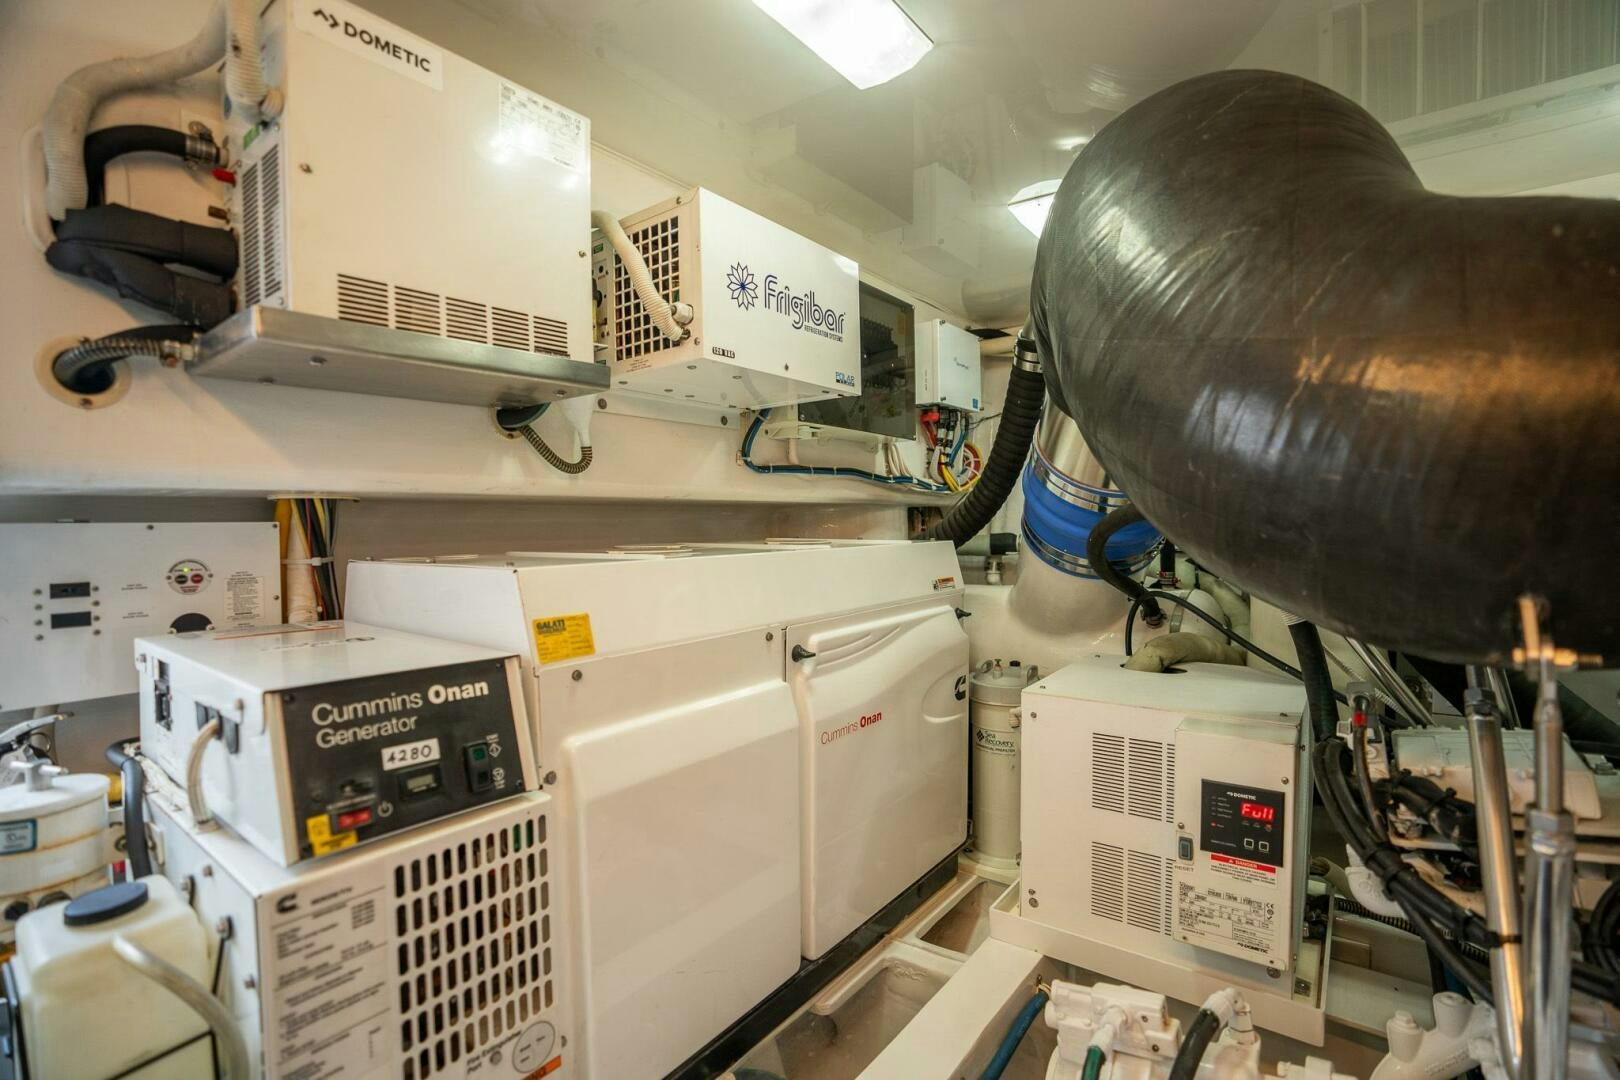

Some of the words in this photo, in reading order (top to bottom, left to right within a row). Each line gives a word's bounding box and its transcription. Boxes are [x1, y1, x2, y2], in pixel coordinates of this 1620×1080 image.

[344, 21, 431, 73] DOMETIC
[764, 274, 845, 334] Frigibar
[312, 691, 423, 726] Cummins
[427, 680, 489, 705] Onan
[316, 714, 417, 749] Generator
[821, 723, 858, 745] Cummins
[860, 712, 882, 727] Onan
[387, 745, 431, 762] 4280
[1233, 792, 1256, 801] DOMETIC
[1242, 802, 1273, 820] Full
[1235, 859, 1258, 869] DANGER
[1244, 943, 1269, 955] DOMETIC
